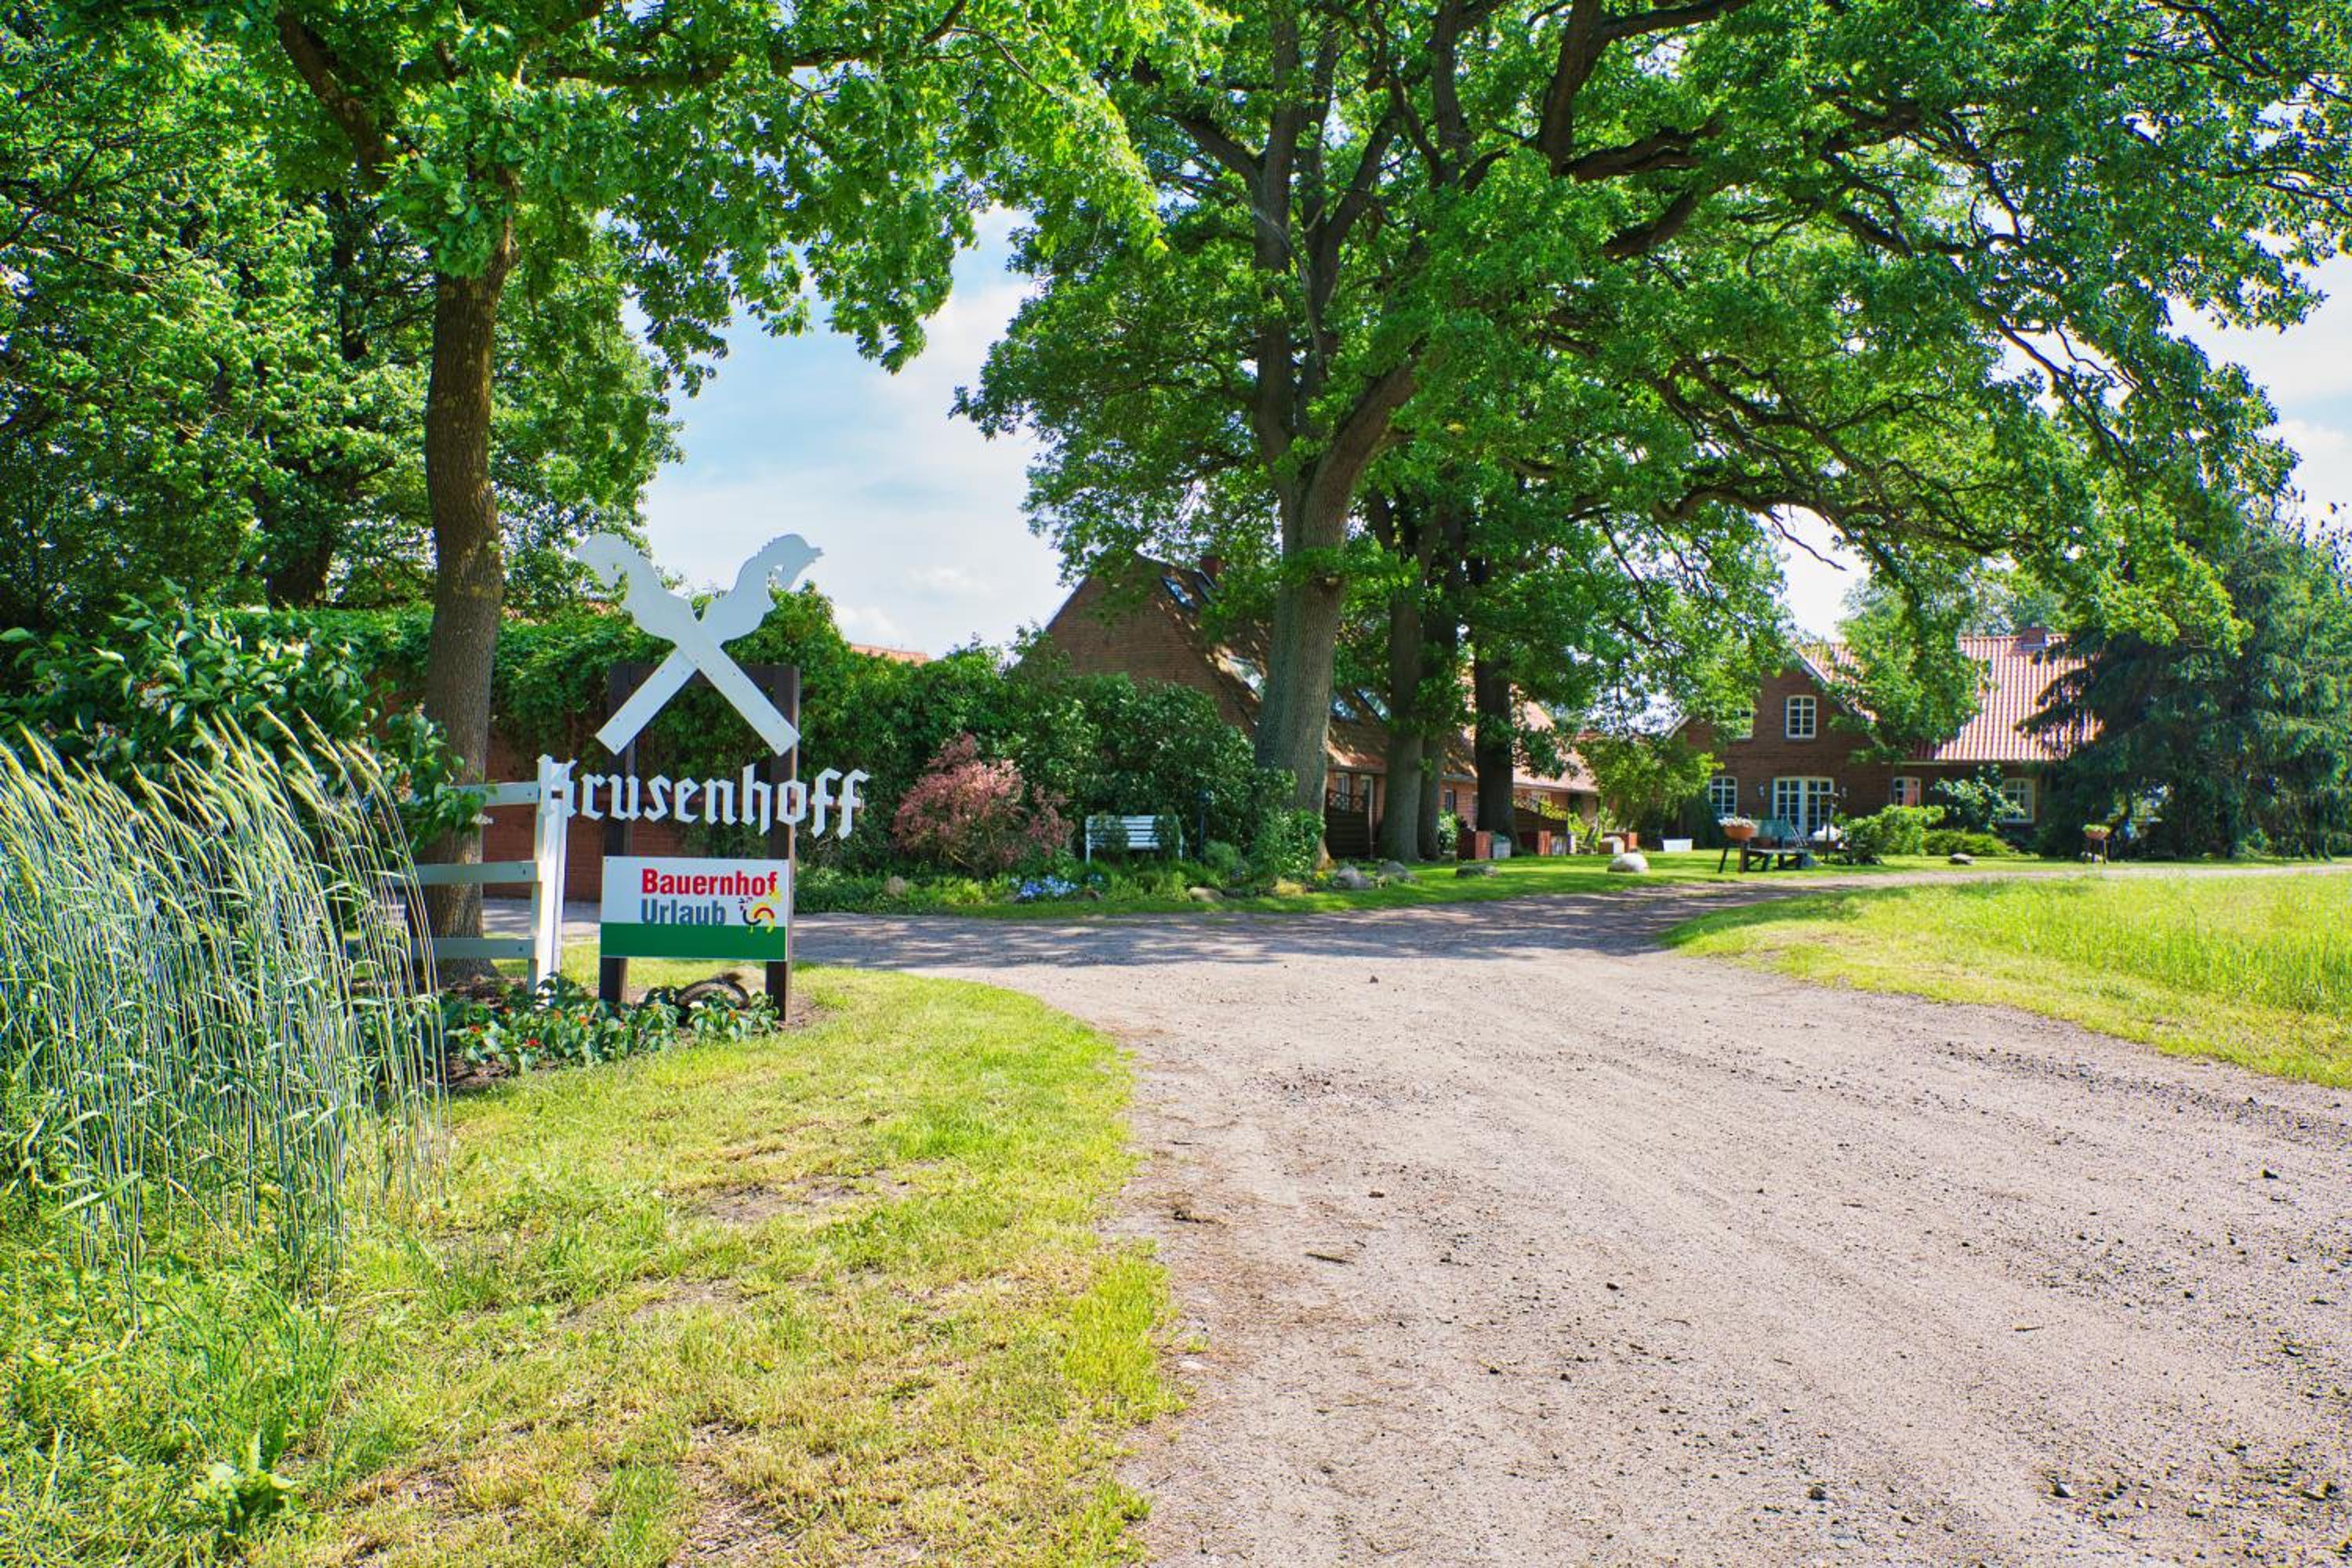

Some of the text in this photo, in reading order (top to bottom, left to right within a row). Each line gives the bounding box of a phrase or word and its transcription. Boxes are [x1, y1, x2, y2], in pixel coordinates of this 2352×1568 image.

[536, 754, 870, 839] Krusenhoff
[641, 868, 778, 897] Bauernhof
[641, 898, 727, 926] Urlaub
